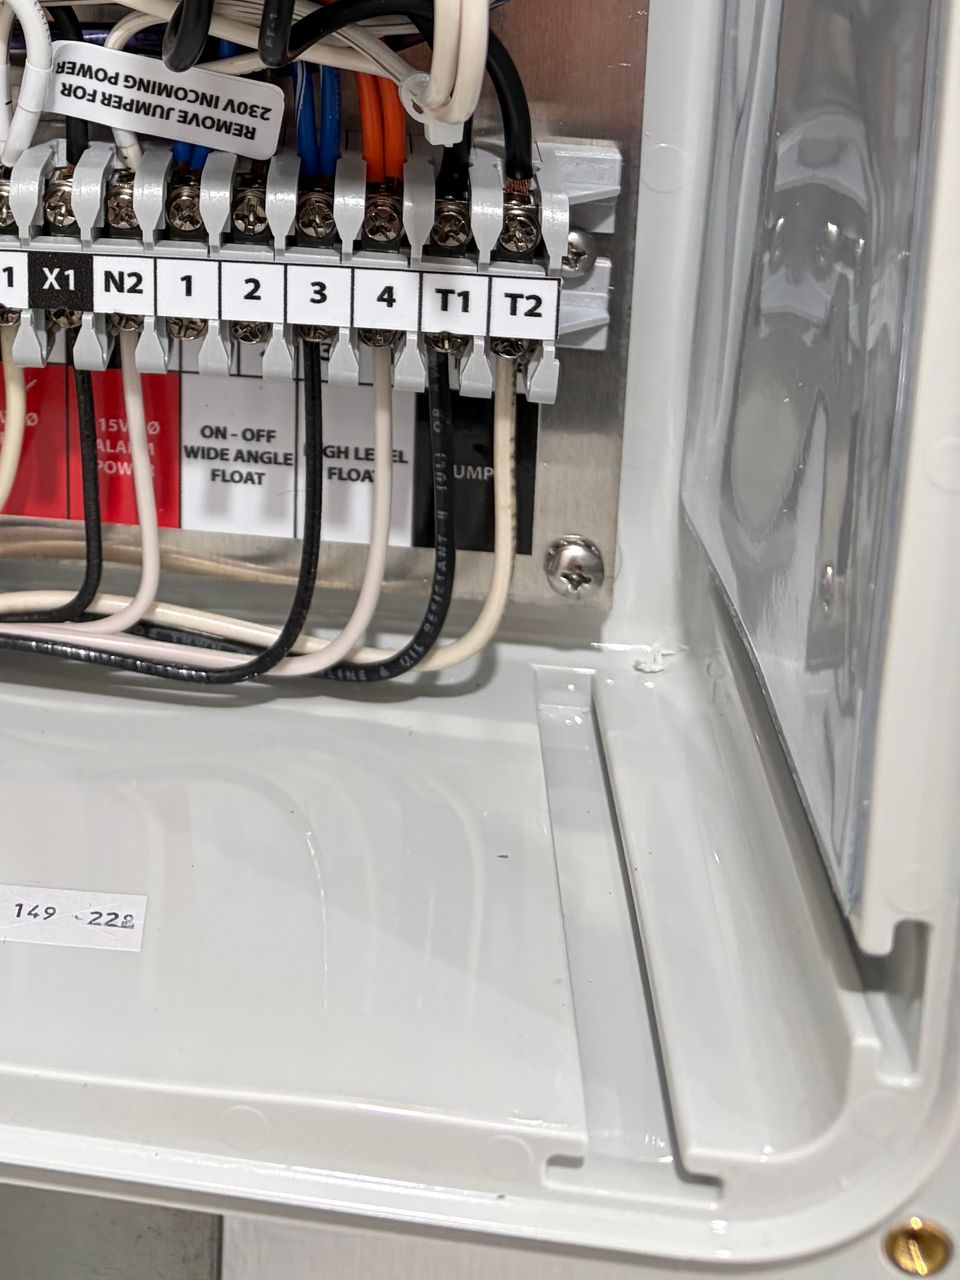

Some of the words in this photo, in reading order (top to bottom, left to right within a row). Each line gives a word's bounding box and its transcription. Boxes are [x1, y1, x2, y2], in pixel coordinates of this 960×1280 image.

[56, 61, 120, 86] POWER
[60, 82, 97, 103] FOR
[123, 75, 221, 109] INCOMING
[100, 91, 175, 120] JUMPER
[222, 98, 273, 121] 230V
[177, 109, 256, 141] REMOVE
[42, 267, 76, 291] X1
[103, 270, 144, 294] N2
[180, 274, 193, 297] 1
[243, 277, 262, 301] 2
[309, 281, 328, 304] 3
[376, 285, 396, 308] 4
[435, 287, 471, 314] T1
[504, 292, 544, 318] T2
[200, 424, 228, 440] ON
[240, 427, 276, 443] OFF
[184, 445, 230, 461] WIDE
[233, 448, 294, 466] ANGLE
[354, 447, 409, 465] LEEL
[211, 470, 265, 486] FLOAT
[453, 464, 495, 481] UMP
[14, 902, 57, 921] 149
